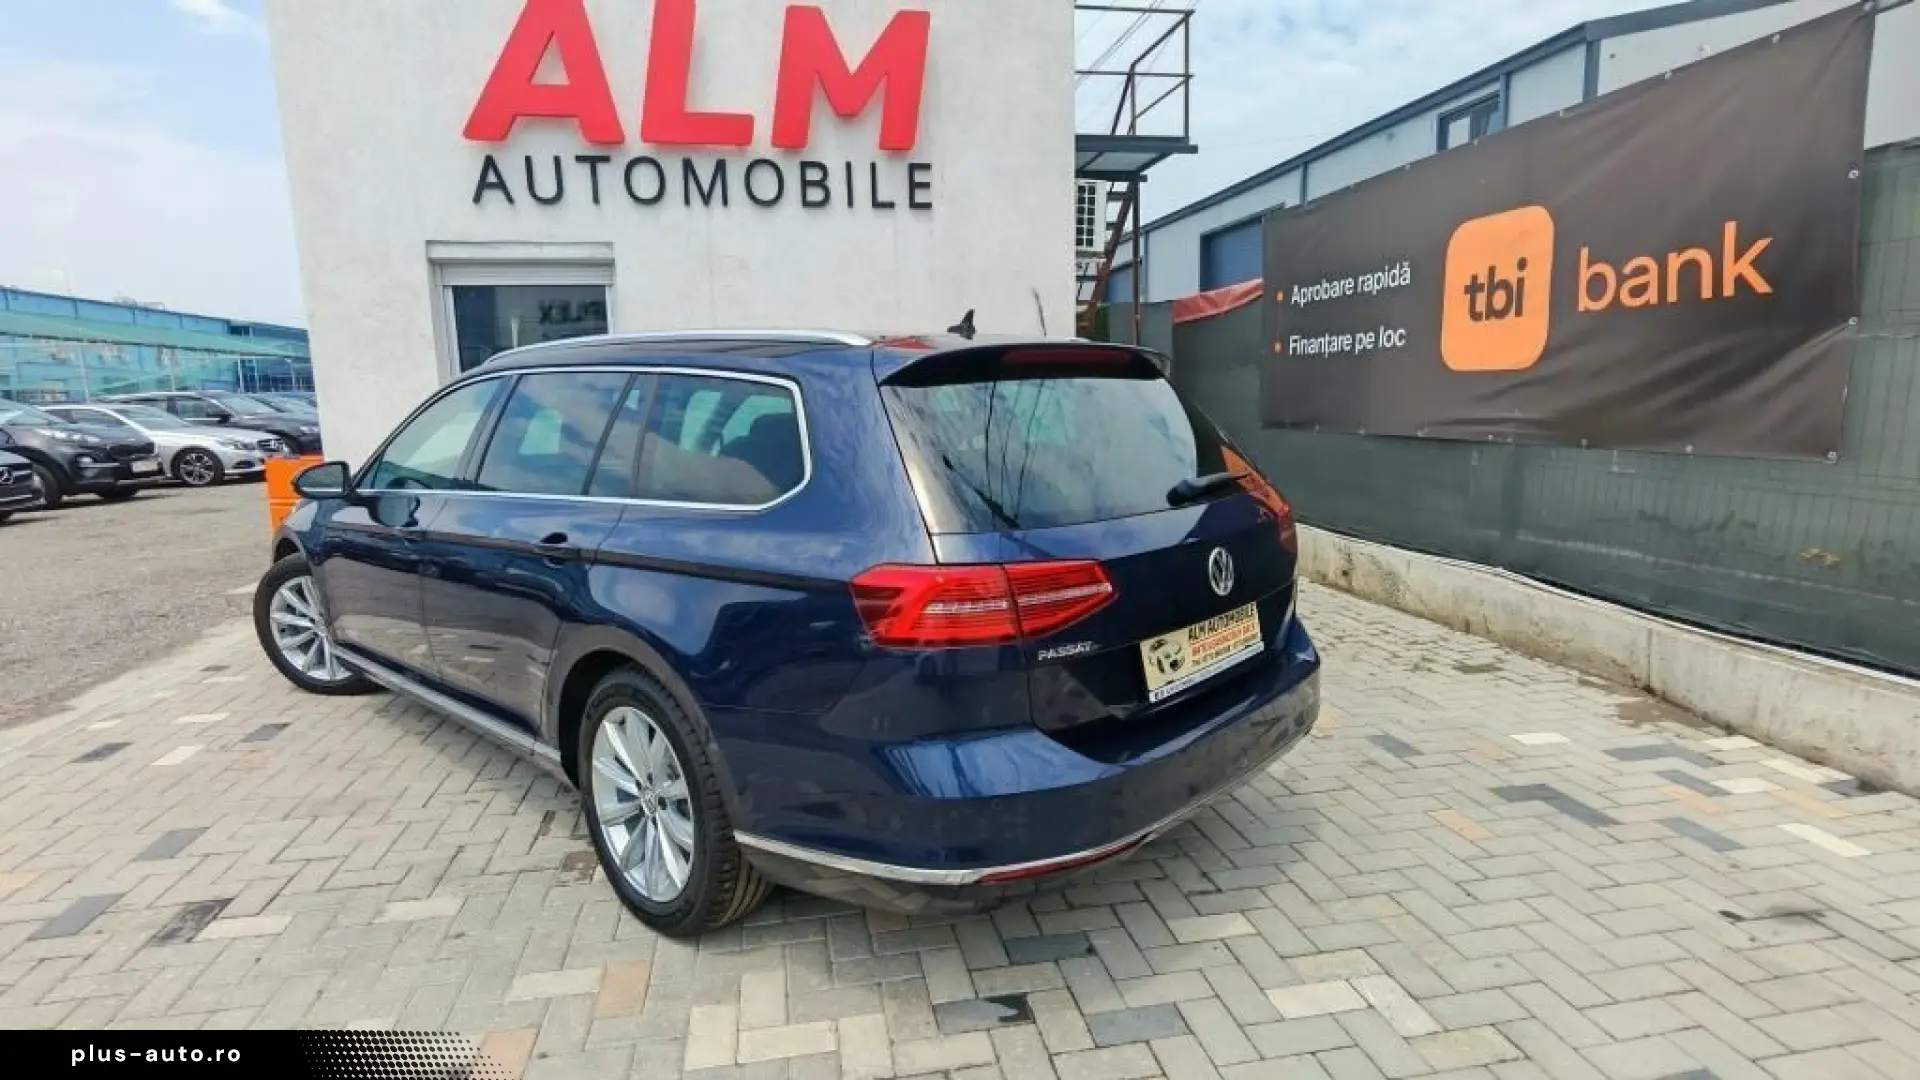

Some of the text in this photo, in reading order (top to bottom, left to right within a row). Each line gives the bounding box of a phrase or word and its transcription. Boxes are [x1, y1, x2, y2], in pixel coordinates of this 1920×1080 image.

[463, 0, 931, 151] ALM
[472, 154, 932, 210] AUTOMOBILE
[1290, 260, 1411, 308] Aprobare rapidă
[1464, 220, 1774, 322] tbi bank
[1355, 331, 1375, 355] pe
[1378, 325, 1407, 348] loc
[1037, 640, 1093, 661] PASSAT
